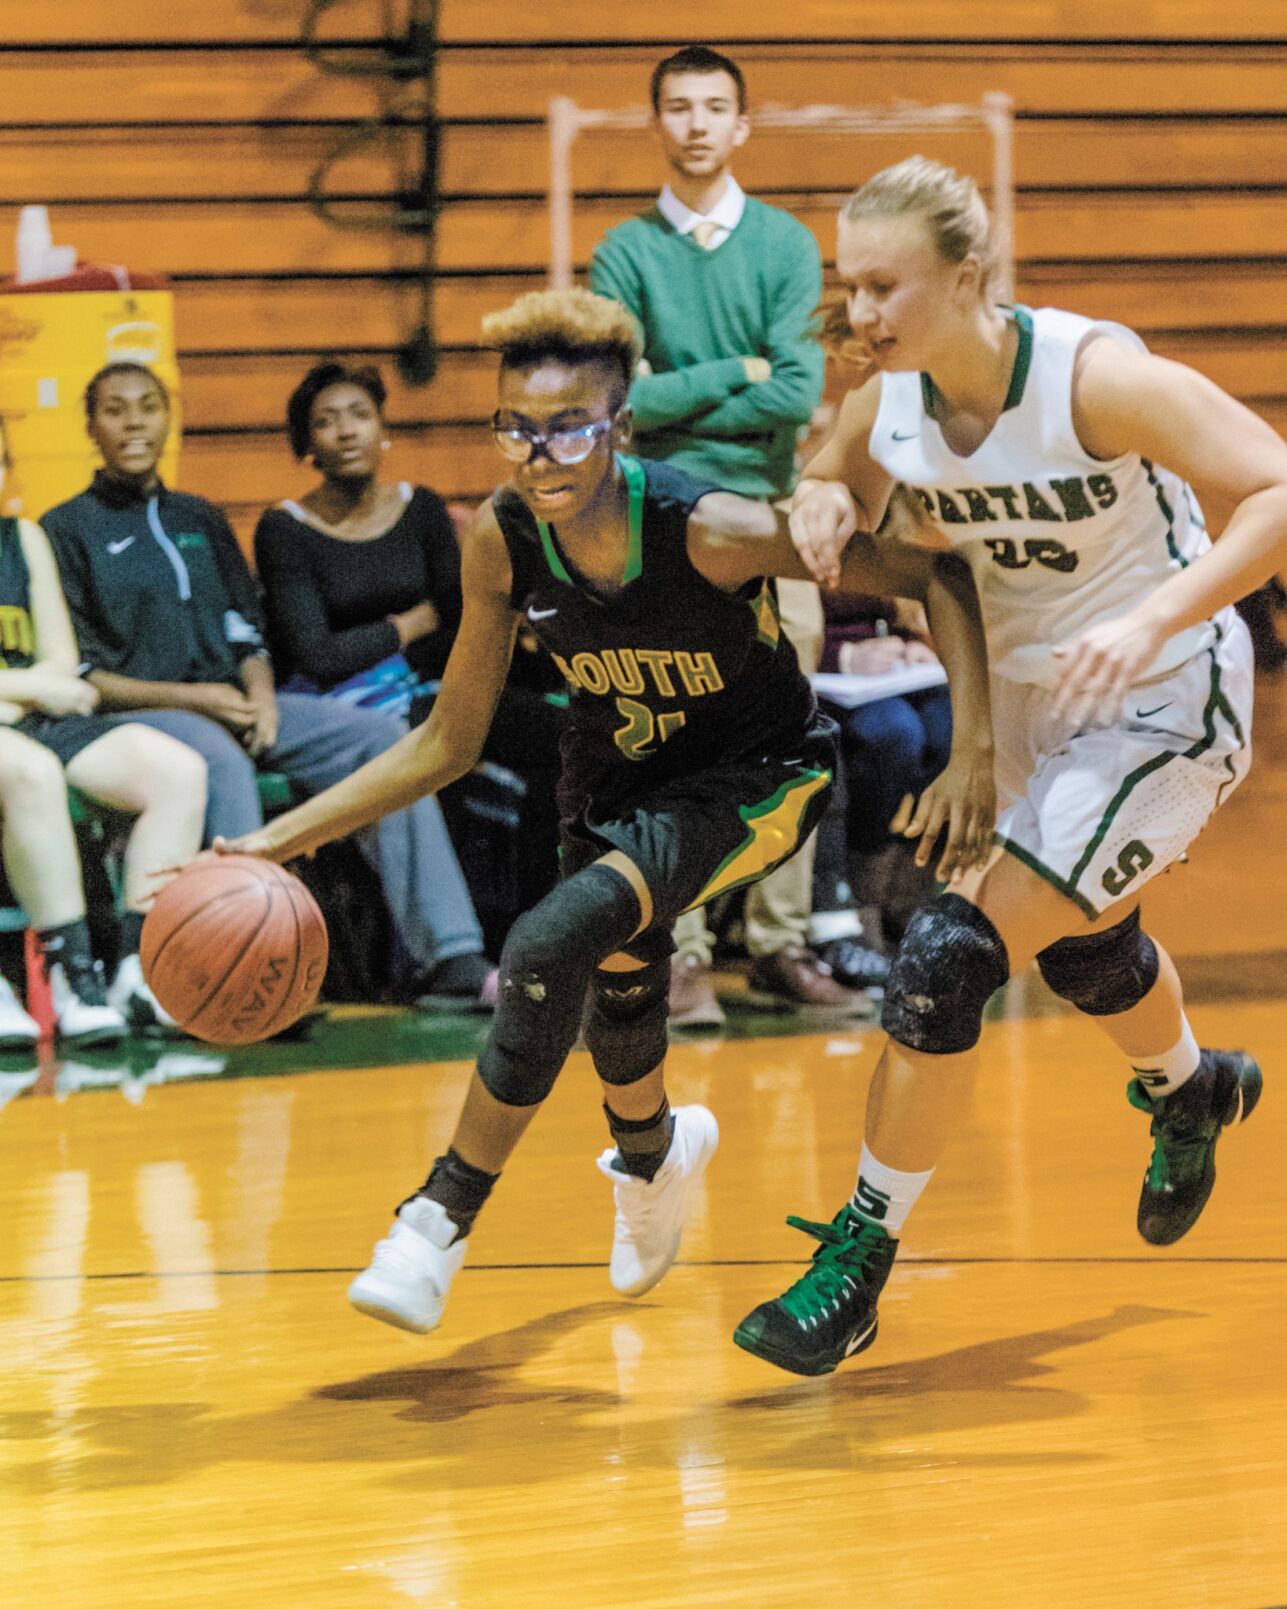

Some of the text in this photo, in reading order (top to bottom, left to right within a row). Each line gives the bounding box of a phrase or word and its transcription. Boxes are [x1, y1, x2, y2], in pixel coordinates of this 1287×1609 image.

[896, 473, 1118, 524] PARTANS
[1102, 839, 1154, 896] S
[853, 1175, 891, 1220] S
